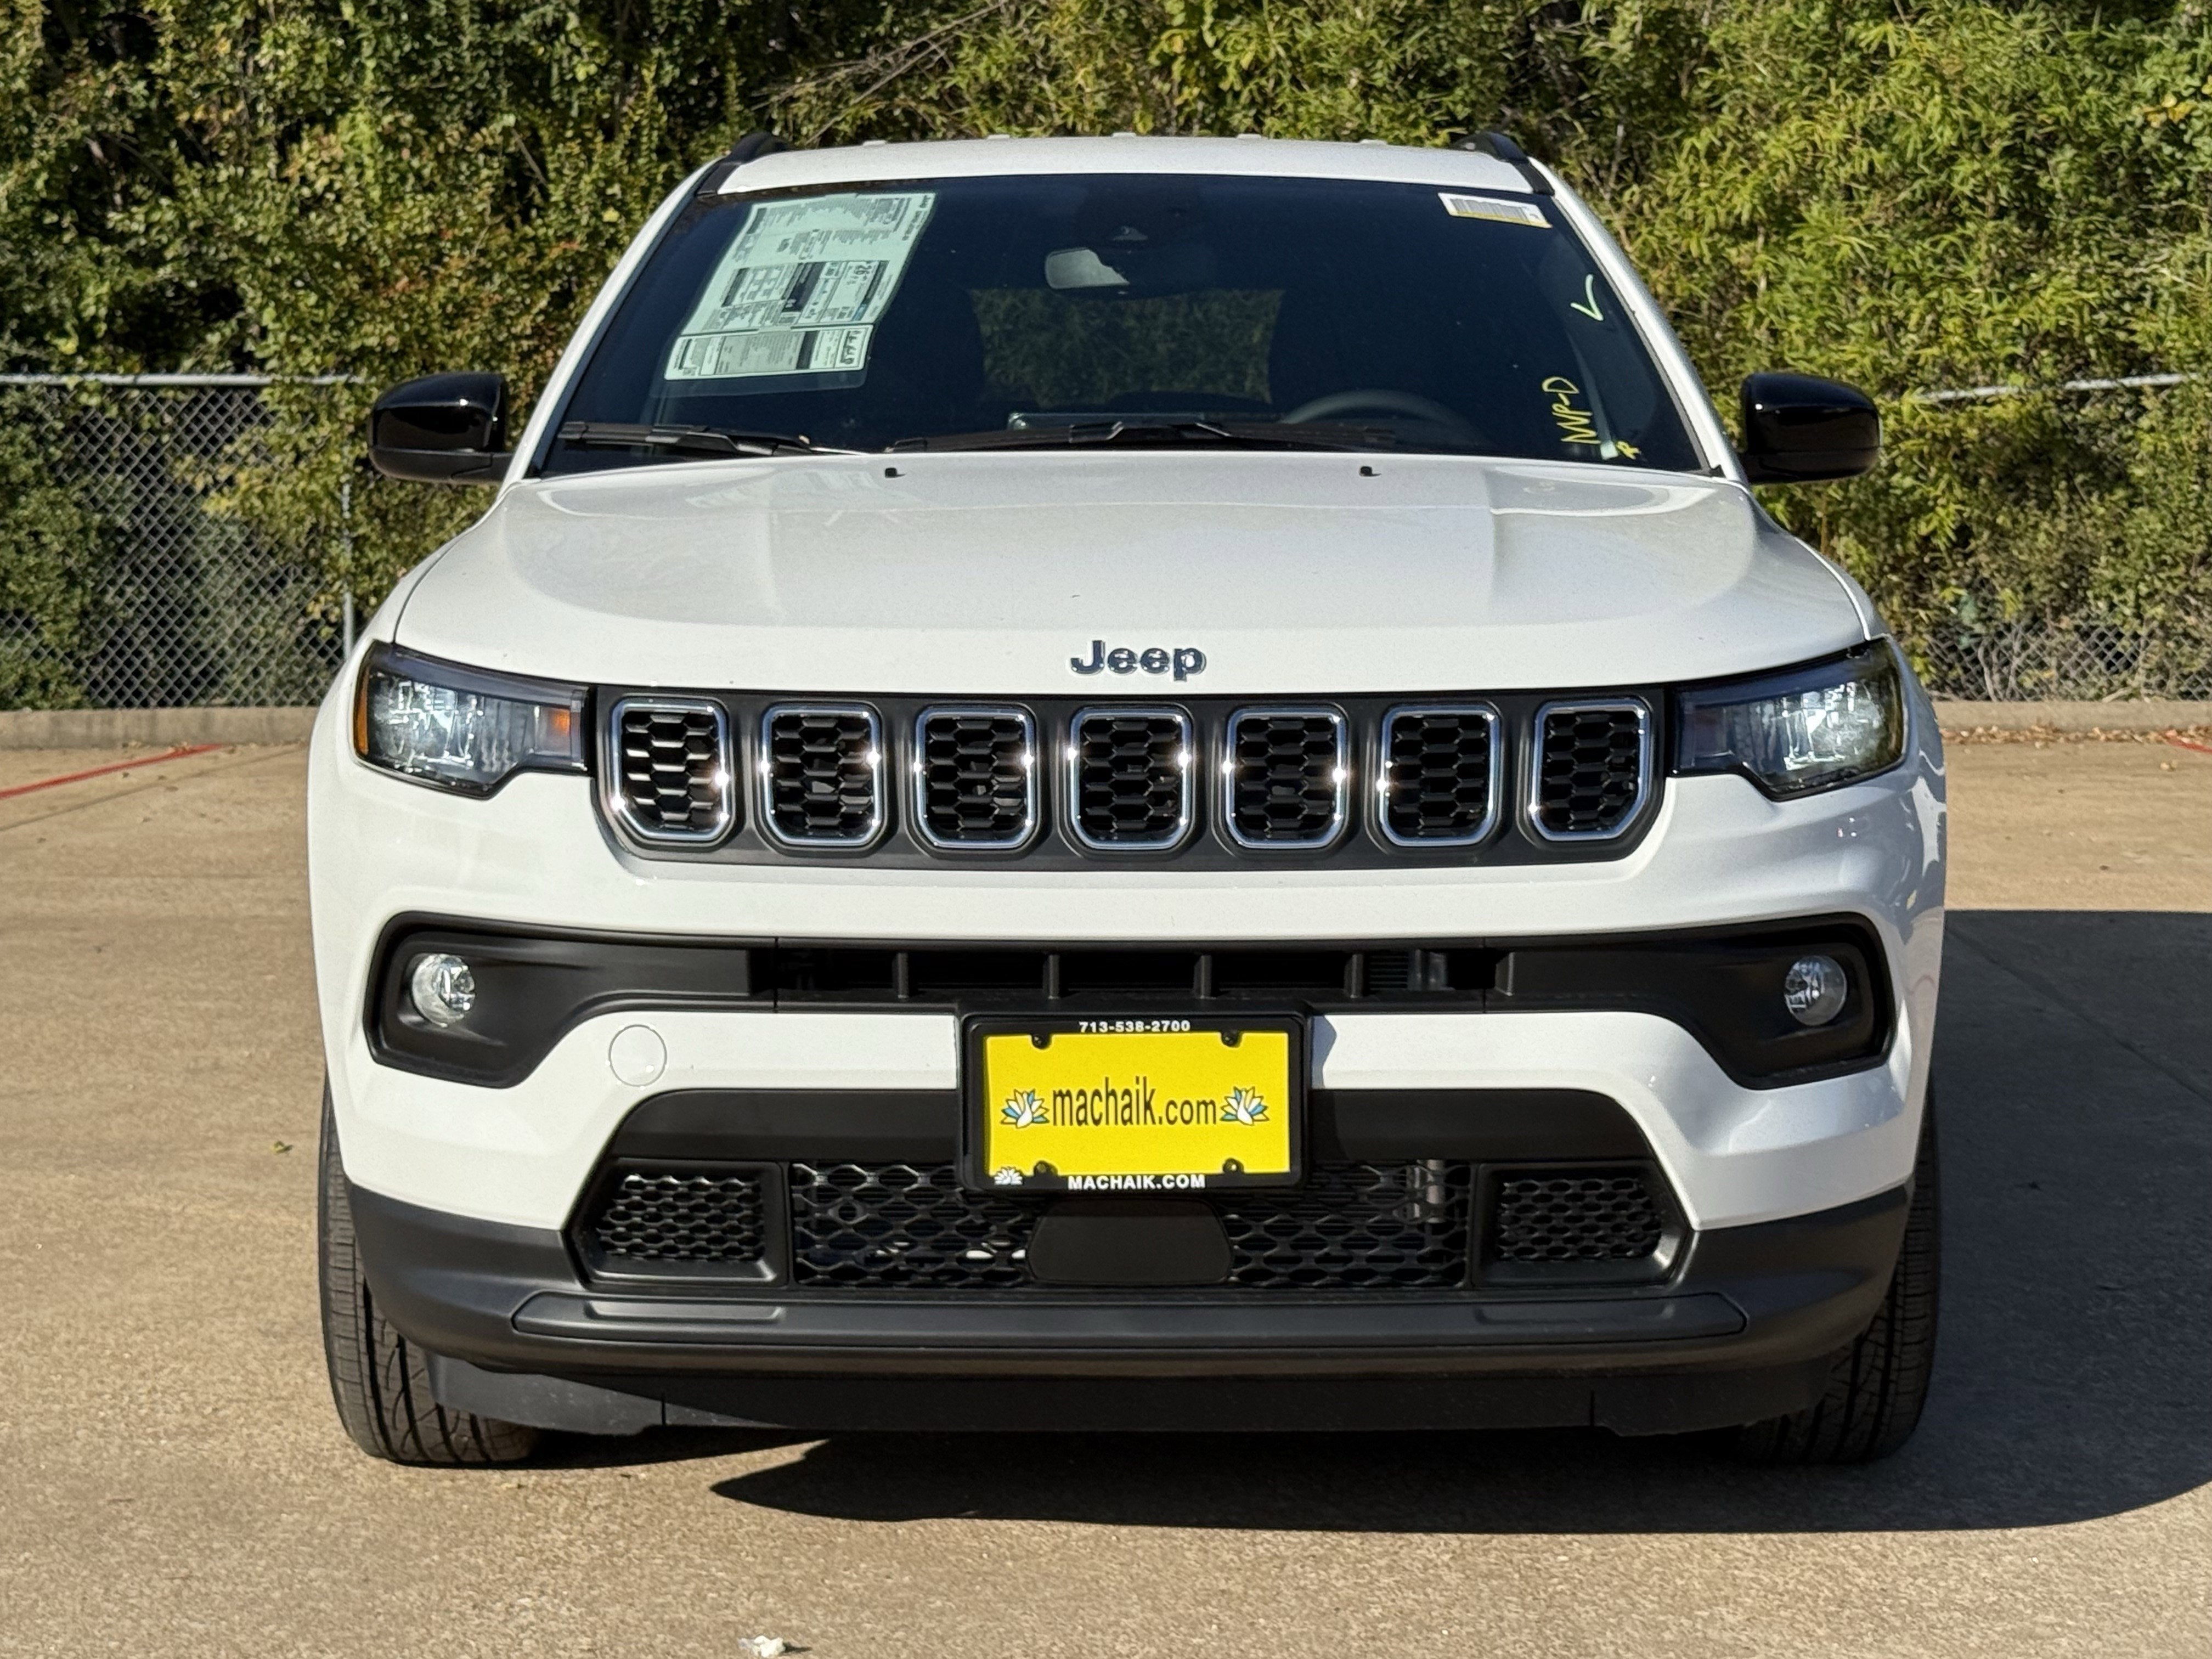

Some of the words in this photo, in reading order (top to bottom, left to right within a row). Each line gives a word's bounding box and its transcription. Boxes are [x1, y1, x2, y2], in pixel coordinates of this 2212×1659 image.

[1070, 640, 1206, 682] Jeep
[1079, 1020, 1191, 1033] 713-538-2700
[1053, 1076, 1217, 1126] machaik.com
[1068, 1174, 1206, 1189] MACHAIK.COM
